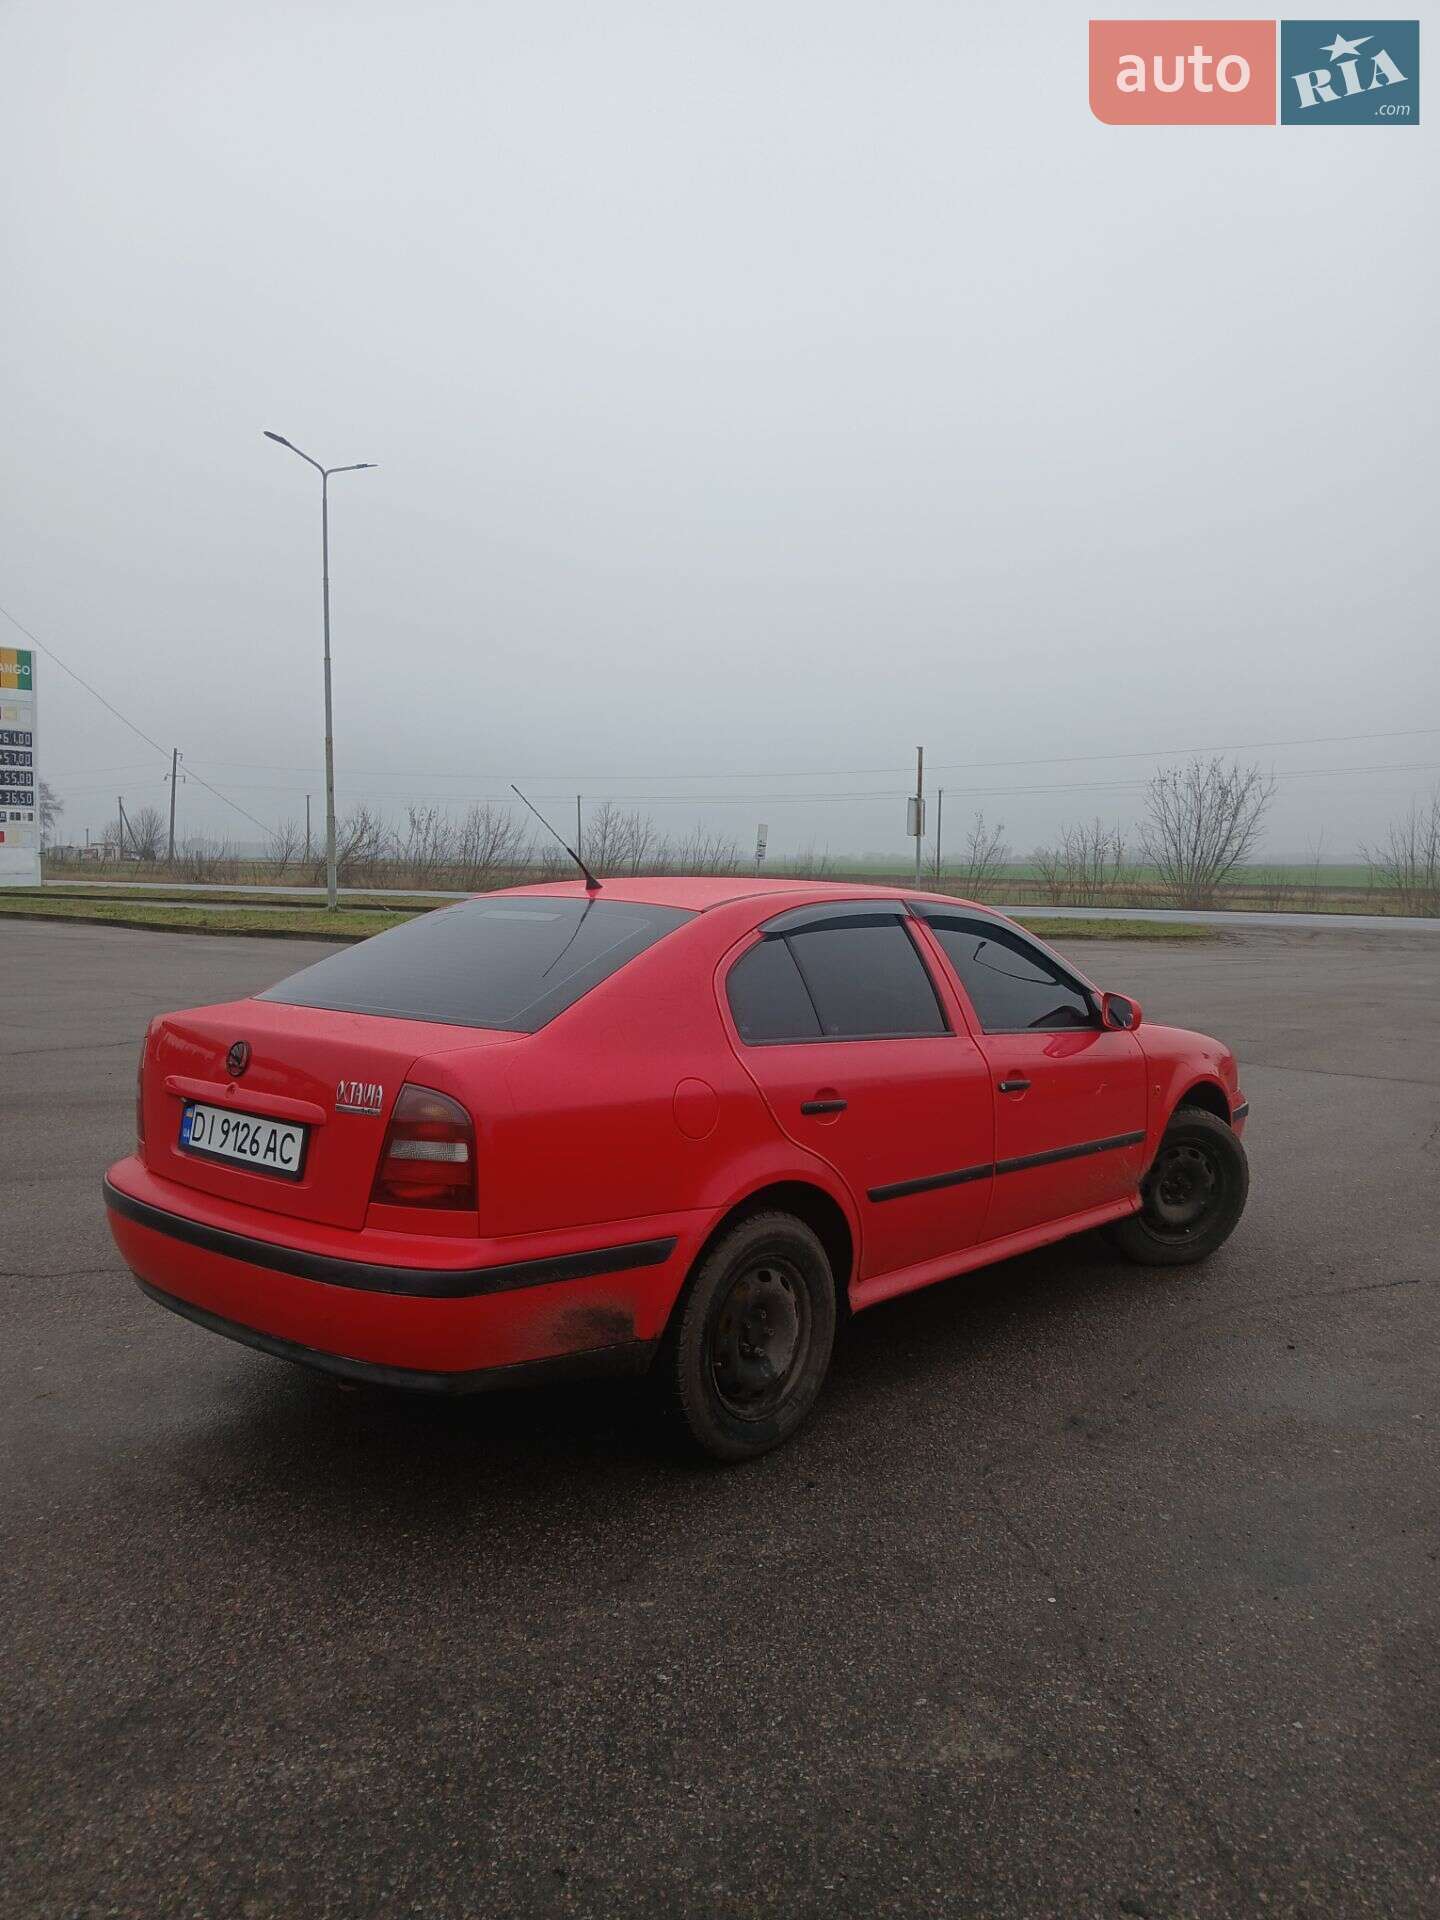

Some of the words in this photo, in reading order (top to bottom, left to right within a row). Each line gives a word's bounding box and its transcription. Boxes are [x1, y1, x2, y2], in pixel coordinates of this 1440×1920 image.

[191, 1111, 215, 1145] DI
[219, 1118, 262, 1156] 9126
[263, 1128, 296, 1164] AC
